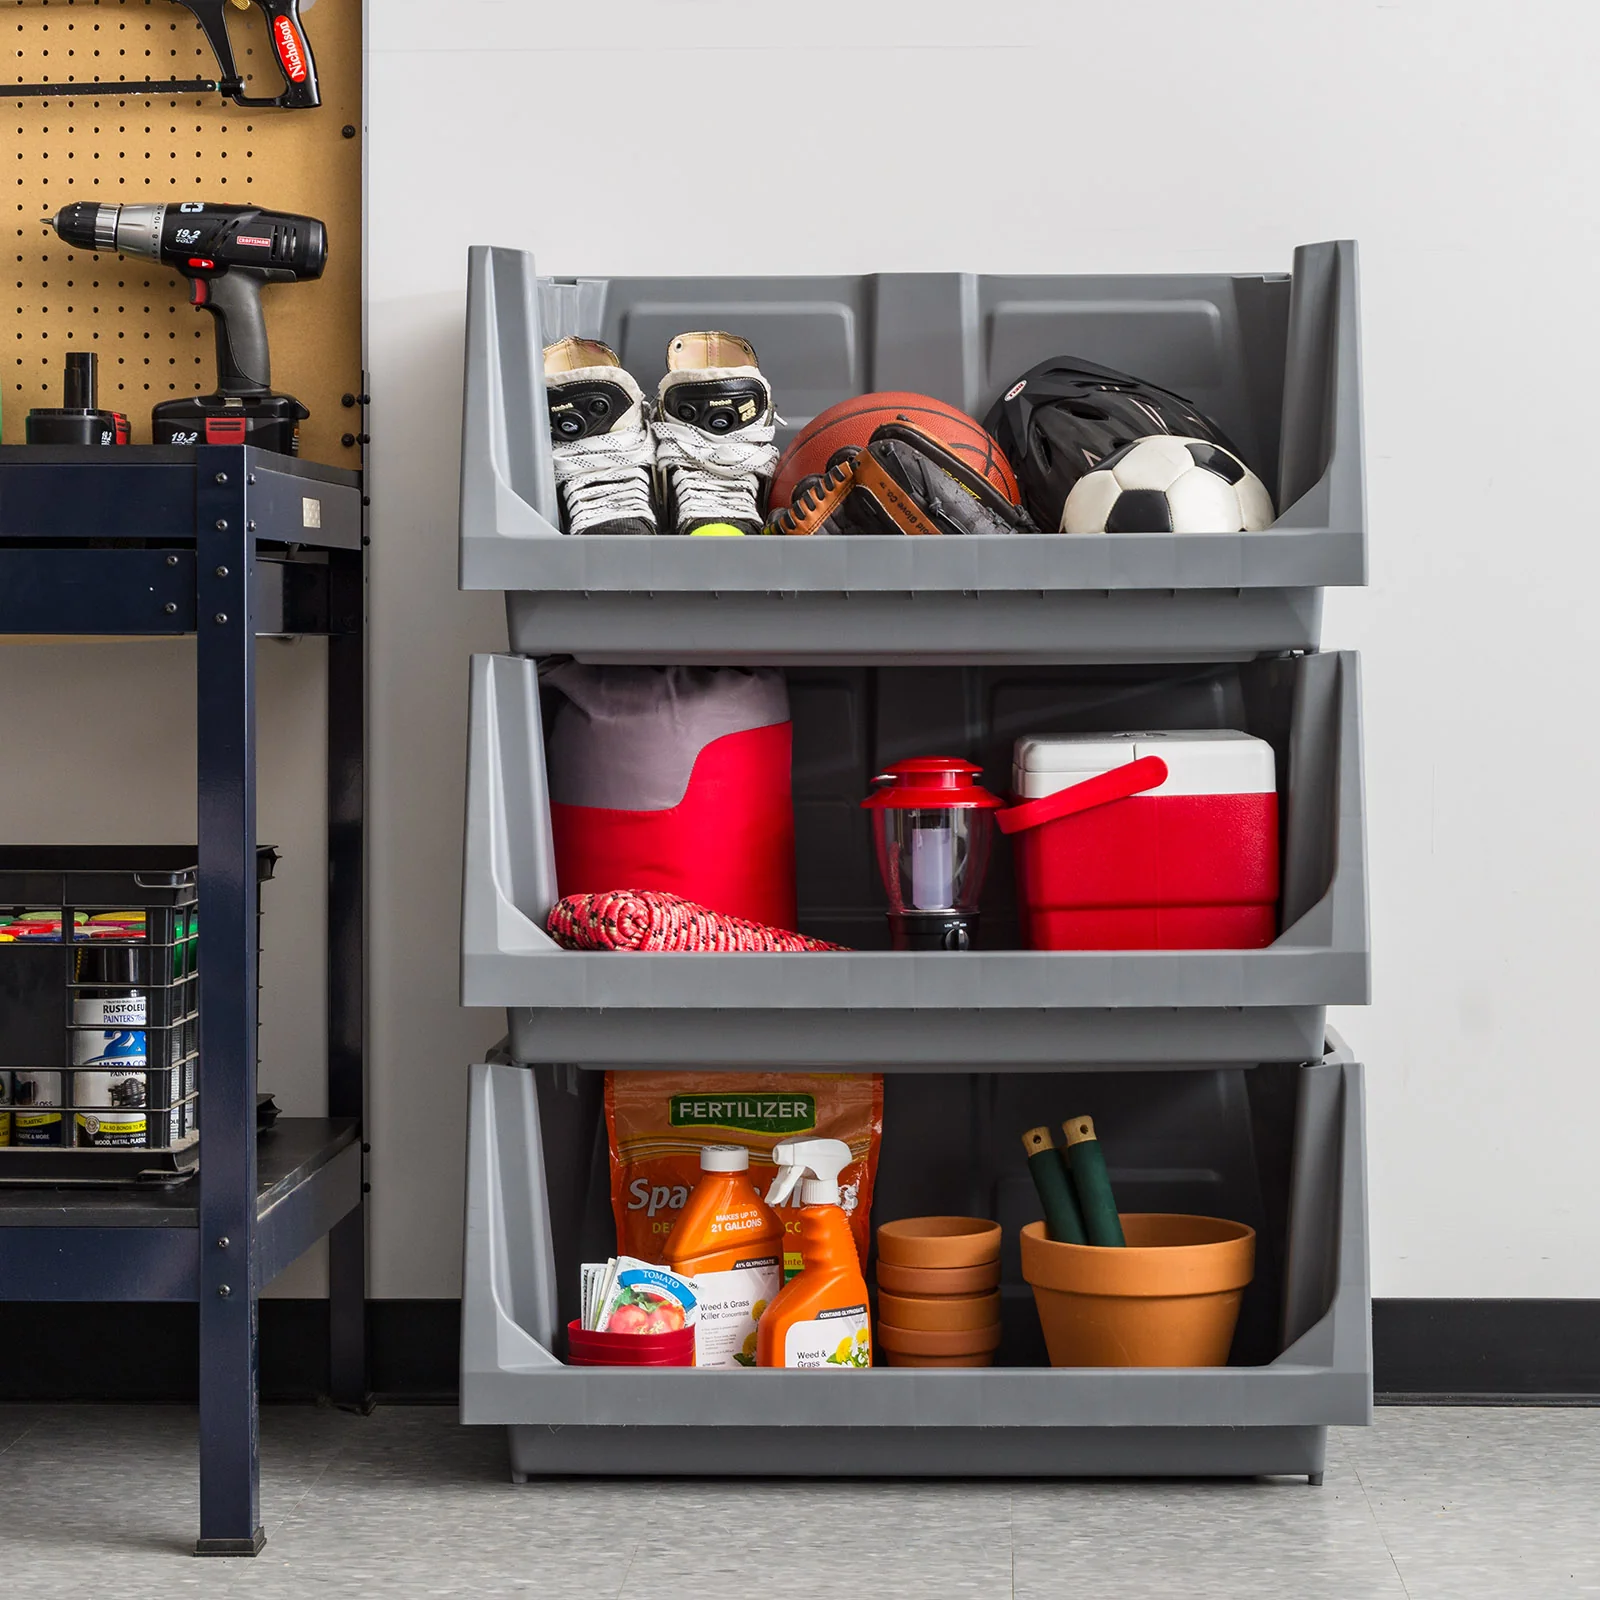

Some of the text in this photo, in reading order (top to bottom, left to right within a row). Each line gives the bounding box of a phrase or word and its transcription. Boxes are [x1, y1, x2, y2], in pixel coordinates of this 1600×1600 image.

[280, 20, 304, 78] Nicholson
[176, 229, 201, 240] 19.2
[238, 237, 270, 246] CRAFTSMAN
[710, 399, 732, 407] Reebok
[171, 432, 198, 443] 19.2
[898, 502, 918, 524] Glove
[103, 1004, 145, 1013] RUST-OLEU
[679, 1102, 808, 1118] FERTILIZER
[627, 1178, 688, 1217] Spa
[715, 1213, 739, 1222] MAKES
[740, 1211, 749, 1219] UP
[711, 1218, 762, 1233] 21 GALLONS
[746, 1259, 775, 1267] GLYPHOSATE
[643, 1270, 680, 1289] TOMATO
[701, 1302, 721, 1311] Weed
[730, 1300, 750, 1309] Grass
[701, 1310, 749, 1320] Killer Concentrate
[797, 1350, 819, 1359] Weed
